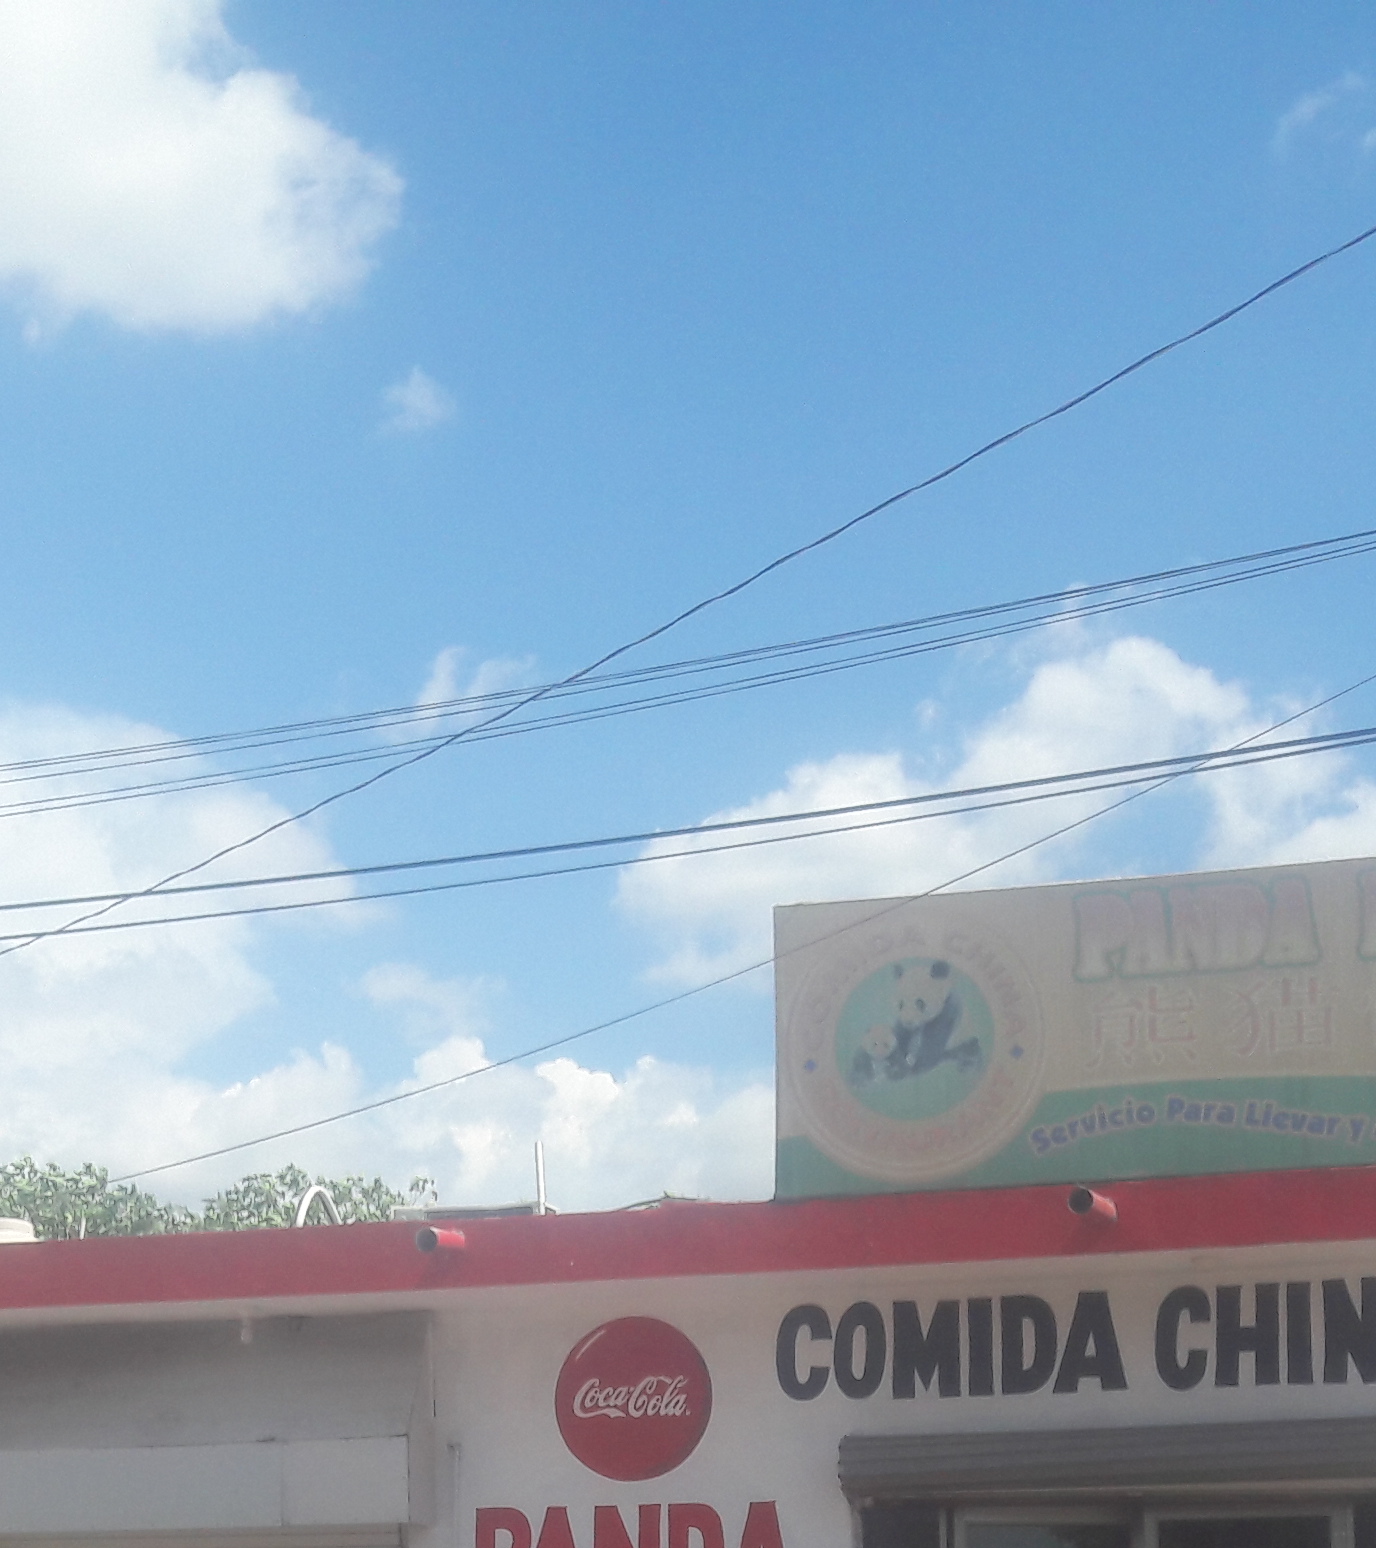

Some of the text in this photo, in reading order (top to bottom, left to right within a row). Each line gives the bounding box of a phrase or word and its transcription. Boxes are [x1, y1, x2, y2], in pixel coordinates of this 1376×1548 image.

[1073, 873, 1320, 982] PANDA
[1030, 1100, 1156, 1154] Servicio
[1166, 1096, 1235, 1125] Para
[1245, 1100, 1343, 1137] Llevar
[1348, 1116, 1364, 1143] y
[776, 1292, 1129, 1402] COMIDA
[573, 1375, 690, 1419] Coca-Cola
